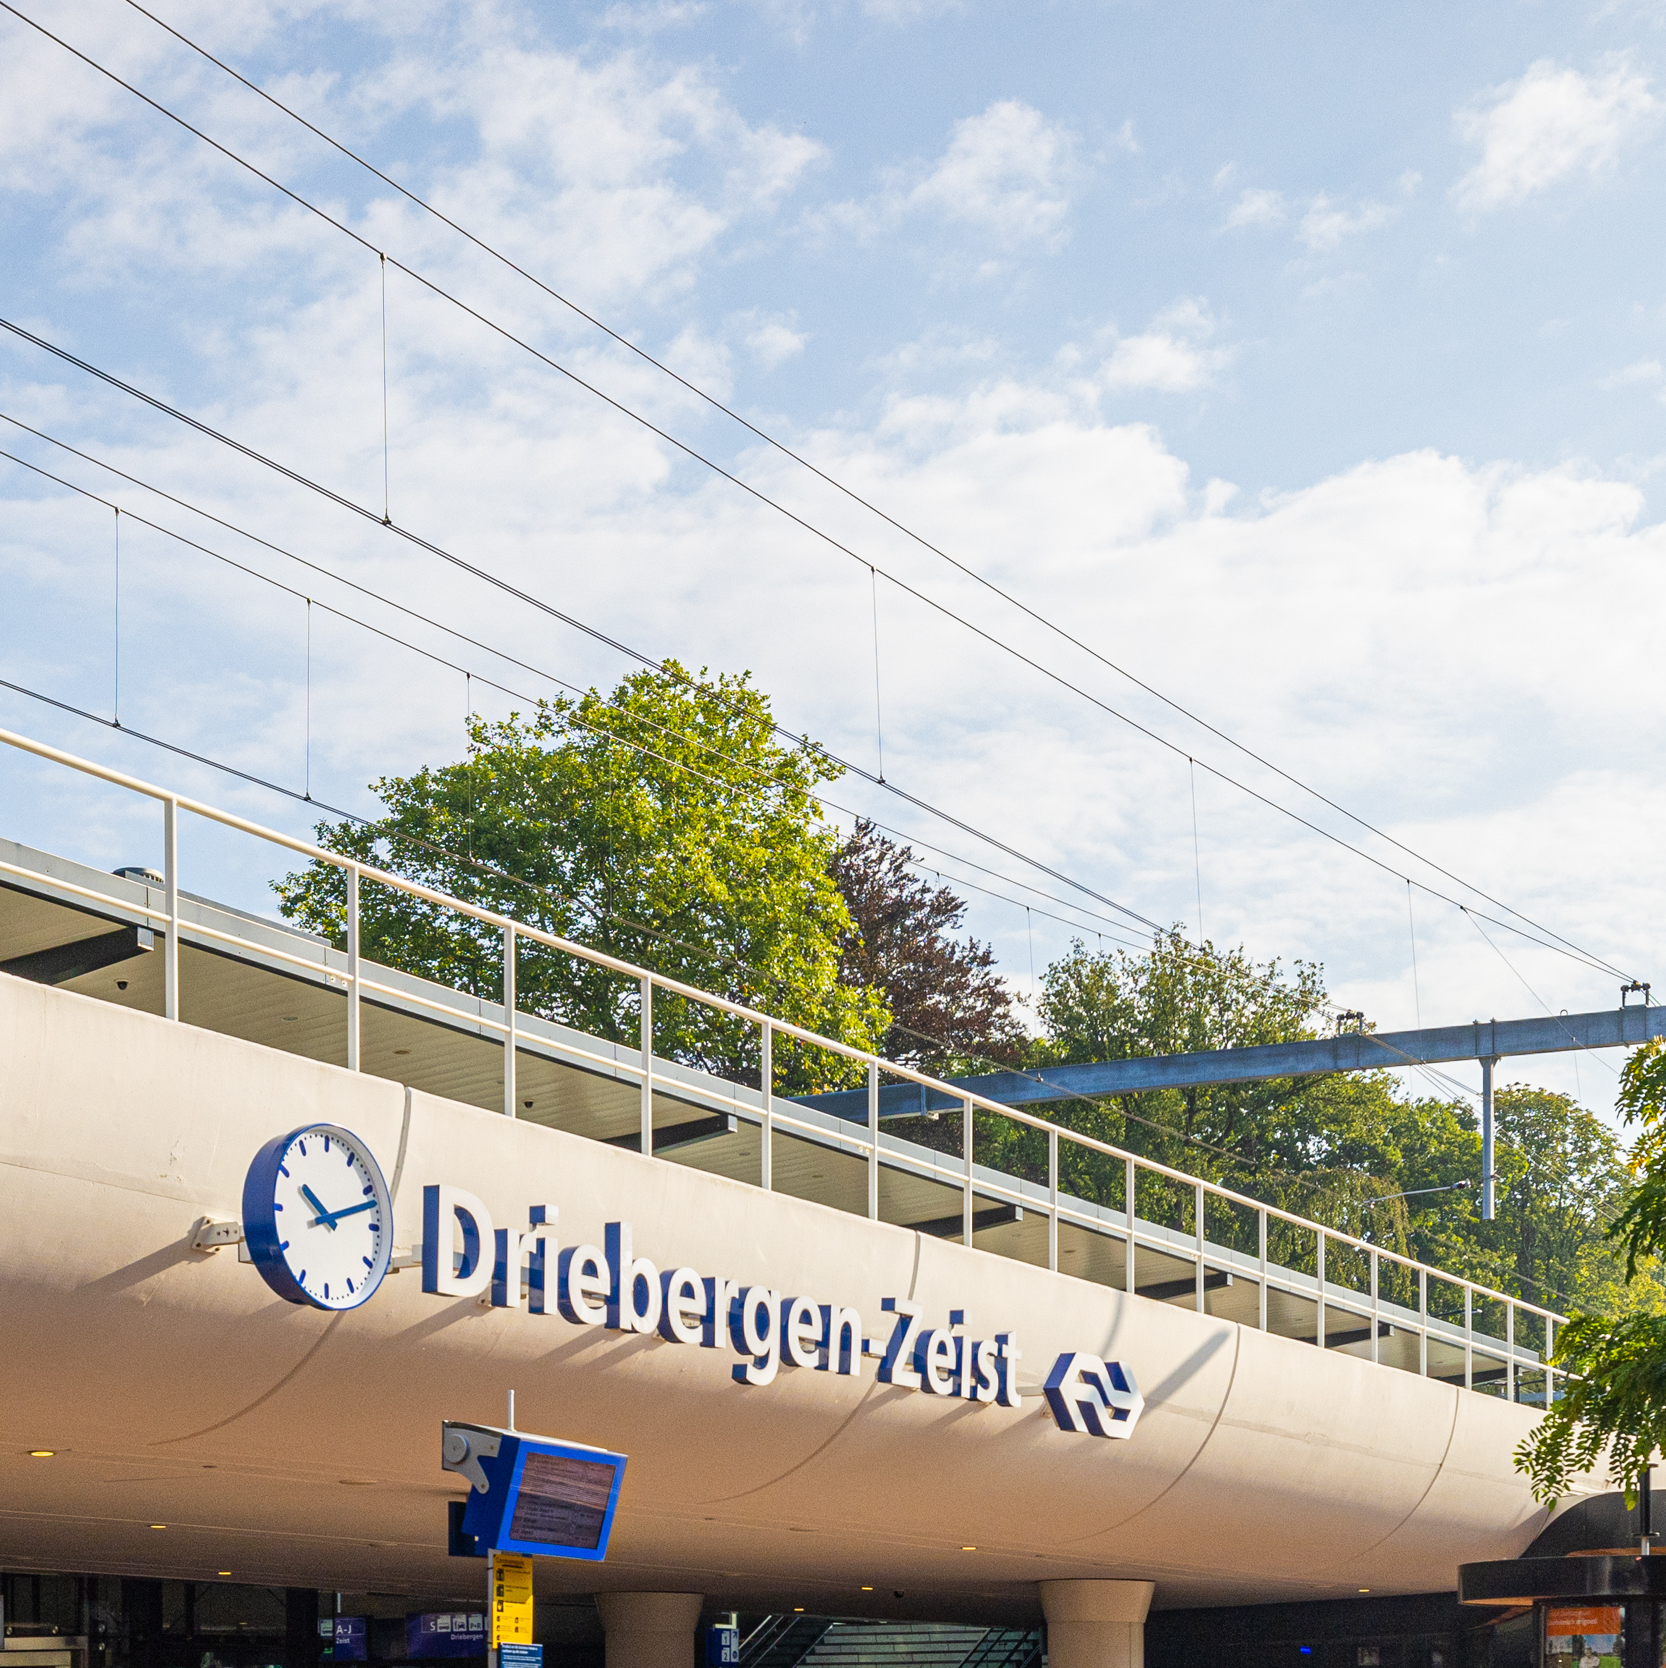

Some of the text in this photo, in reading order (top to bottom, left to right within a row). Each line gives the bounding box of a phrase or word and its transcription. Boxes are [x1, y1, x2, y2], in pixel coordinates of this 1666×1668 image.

[421, 1183, 1023, 1407] Driebergen-Zeist
[336, 1625, 352, 1635] A-J
[723, 1652, 728, 1660] 2
